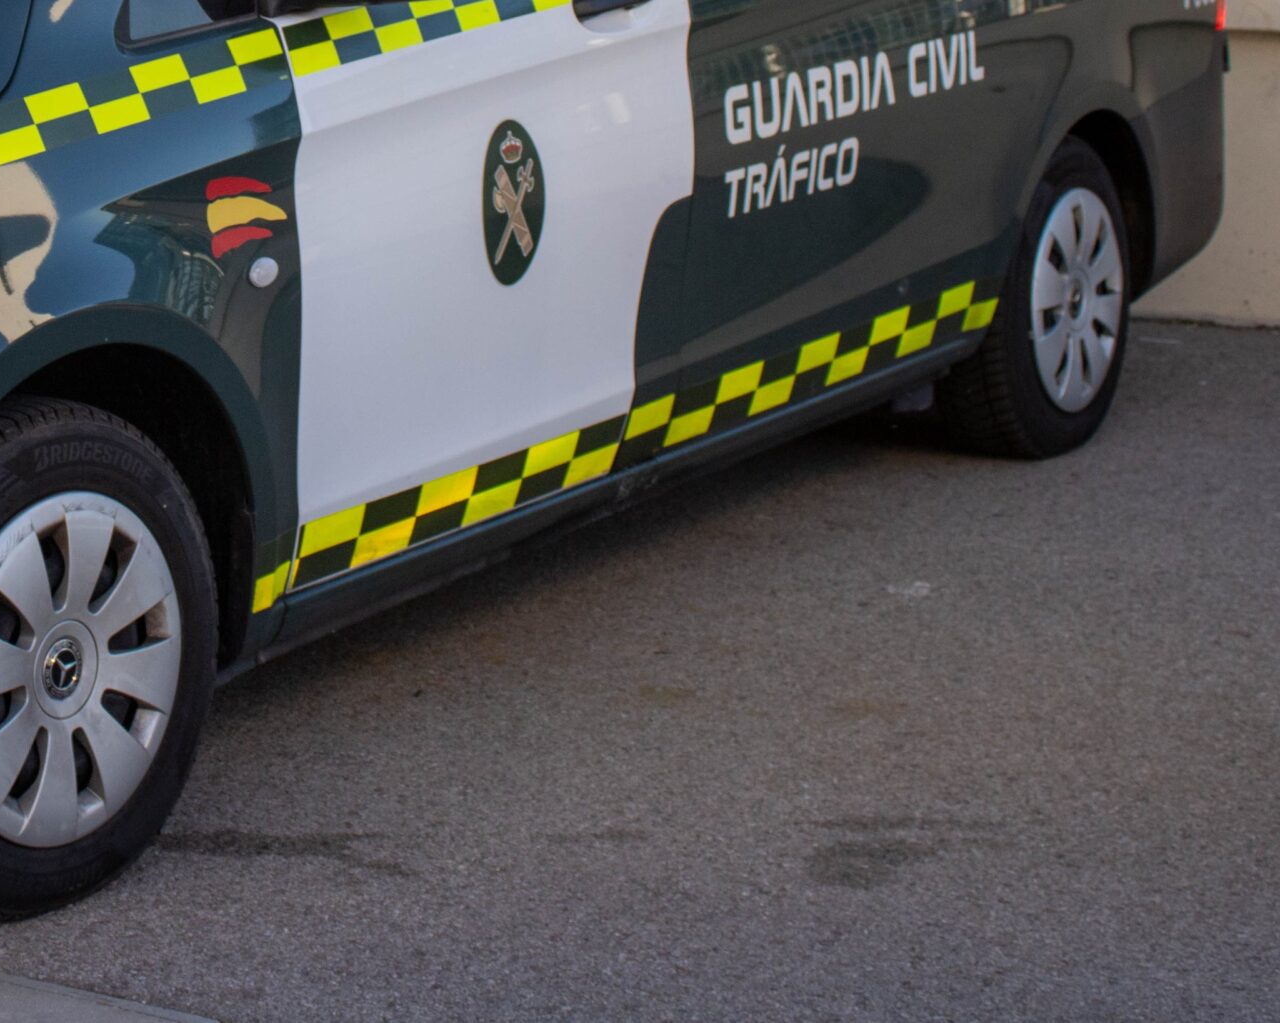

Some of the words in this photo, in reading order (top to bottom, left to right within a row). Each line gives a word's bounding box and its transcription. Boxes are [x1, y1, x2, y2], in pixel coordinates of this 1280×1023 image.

[723, 50, 897, 145] GUARDIA
[906, 29, 986, 98] CIVIL
[724, 136, 860, 219] TRÁFICO
[33, 440, 153, 484] BRIDGESTONE
